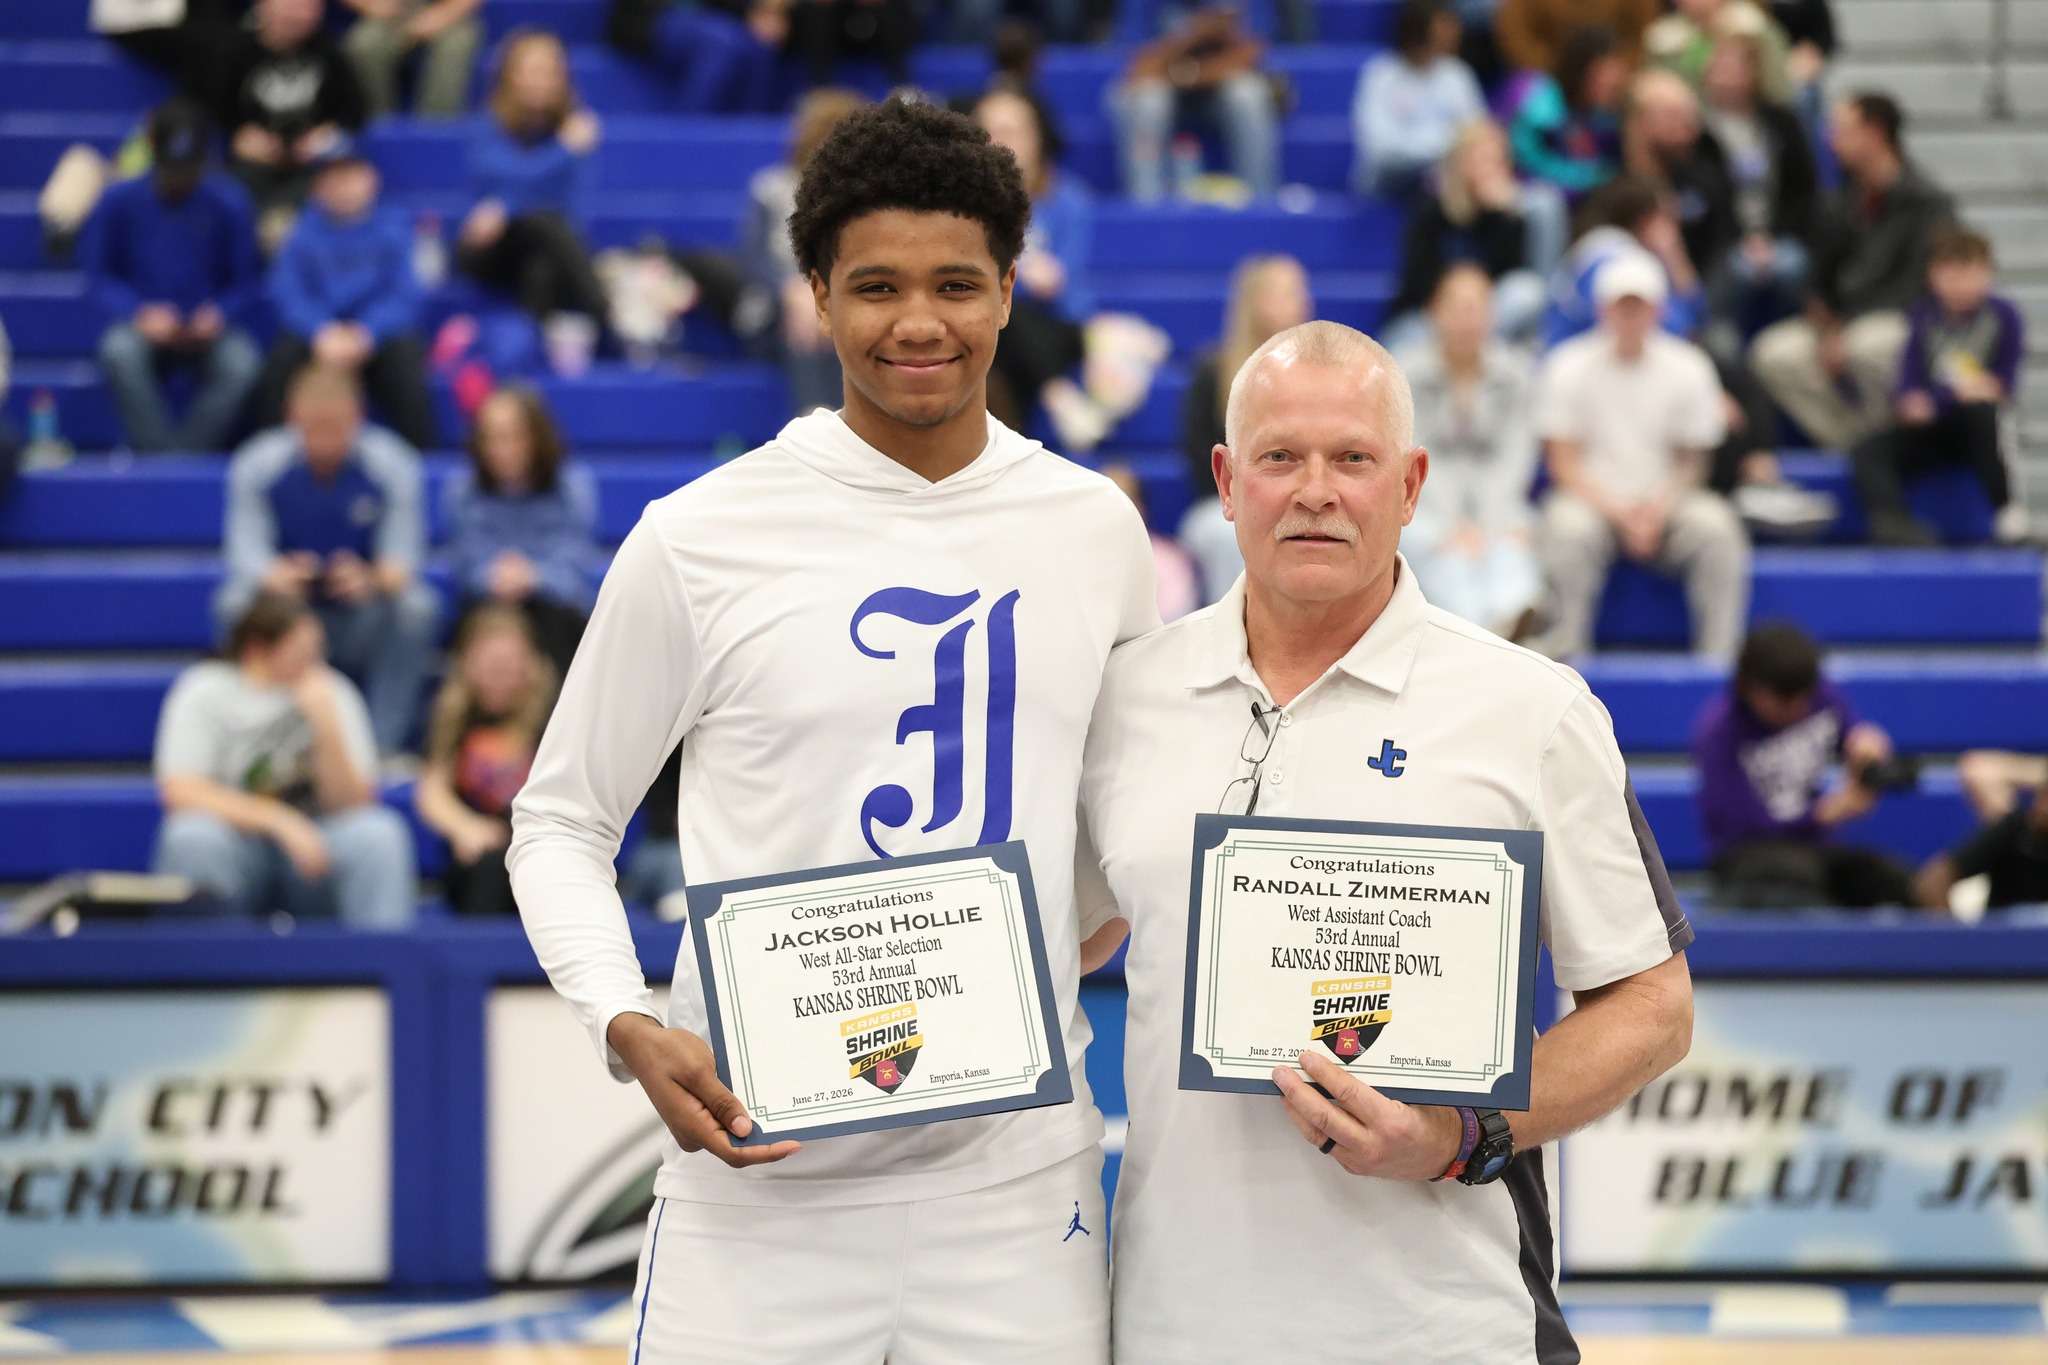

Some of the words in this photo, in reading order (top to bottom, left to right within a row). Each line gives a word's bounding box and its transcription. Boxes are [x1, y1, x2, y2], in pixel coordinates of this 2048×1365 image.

[1367, 739, 1407, 778] JC
[1290, 856, 1435, 875] Congratulations
[791, 890, 934, 920] Congratulations
[1233, 875, 1341, 897] RANDALL
[1348, 881, 1490, 905] ZIMMERMAN
[765, 920, 883, 951] JACKSON
[890, 907, 982, 933] HOLLIE
[1288, 904, 1320, 922] West
[1324, 907, 1384, 926] Assistant
[1389, 910, 1432, 928] Coach
[799, 952, 831, 970] West
[835, 945, 883, 966] All-Star
[886, 936, 943, 958] Selection
[1315, 928, 1348, 946] 53rd
[1351, 930, 1400, 948] Annual
[832, 966, 865, 986] 53rd
[869, 959, 917, 982] Annual
[1271, 947, 1330, 971] KANSAS
[1335, 950, 1390, 974] SHRINE
[1395, 954, 1443, 977] BOWL
[793, 990, 853, 1018] KANSAS
[857, 981, 912, 1008] SHRINE
[914, 975, 963, 1000] BOWL
[1317, 979, 1387, 993] KANSAS
[845, 1006, 912, 1032] KANSAS
[1313, 993, 1390, 1016] SHRINE
[846, 1019, 918, 1054] SHRINE
[1321, 1013, 1379, 1035] BOWL
[859, 1040, 912, 1072] BOWL
[1249, 1046, 1269, 1057] June
[1272, 1047, 1286, 1058] 27,
[1390, 1055, 1424, 1067] Emporia,
[1425, 1057, 1451, 1067] Kansas
[929, 1071, 963, 1085] Emporia,
[965, 1067, 990, 1079] Kansas
[147, 1078, 366, 1134] CITY
[792, 1094, 812, 1107] June
[815, 1092, 829, 1102] 27,
[831, 1088, 854, 1098] 2026
[1887, 1066, 2005, 1125] OF
[0, 1163, 300, 1217] CHOOL
[1654, 1149, 1886, 1207] BLUE
